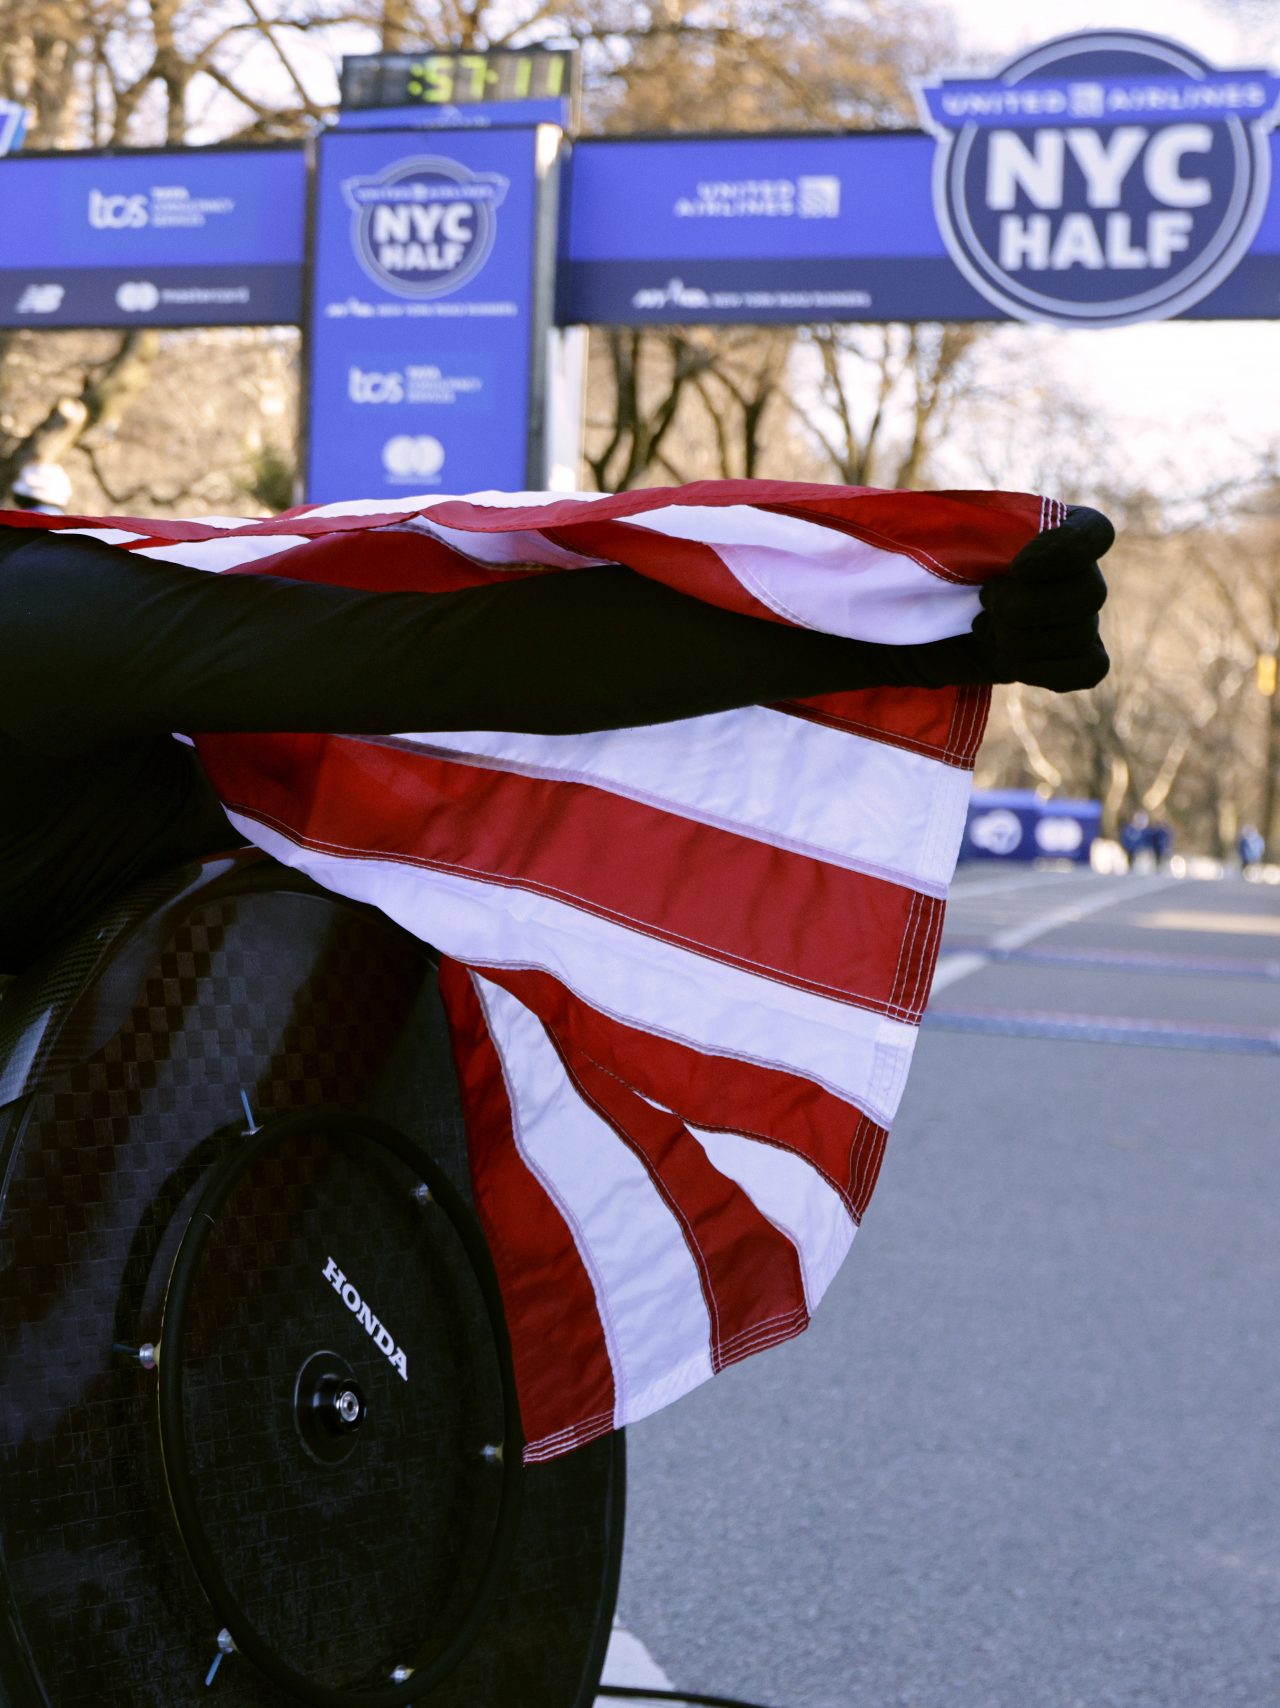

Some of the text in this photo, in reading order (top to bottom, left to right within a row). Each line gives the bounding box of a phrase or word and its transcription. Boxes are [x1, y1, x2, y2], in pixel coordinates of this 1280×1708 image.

[941, 83, 1266, 116] UNITED AIRLINES
[986, 123, 1213, 210] NYC
[373, 202, 473, 244] NYC
[999, 211, 1194, 271] HALF
[378, 242, 466, 271] HALF
[322, 1256, 408, 1382] HONDA
